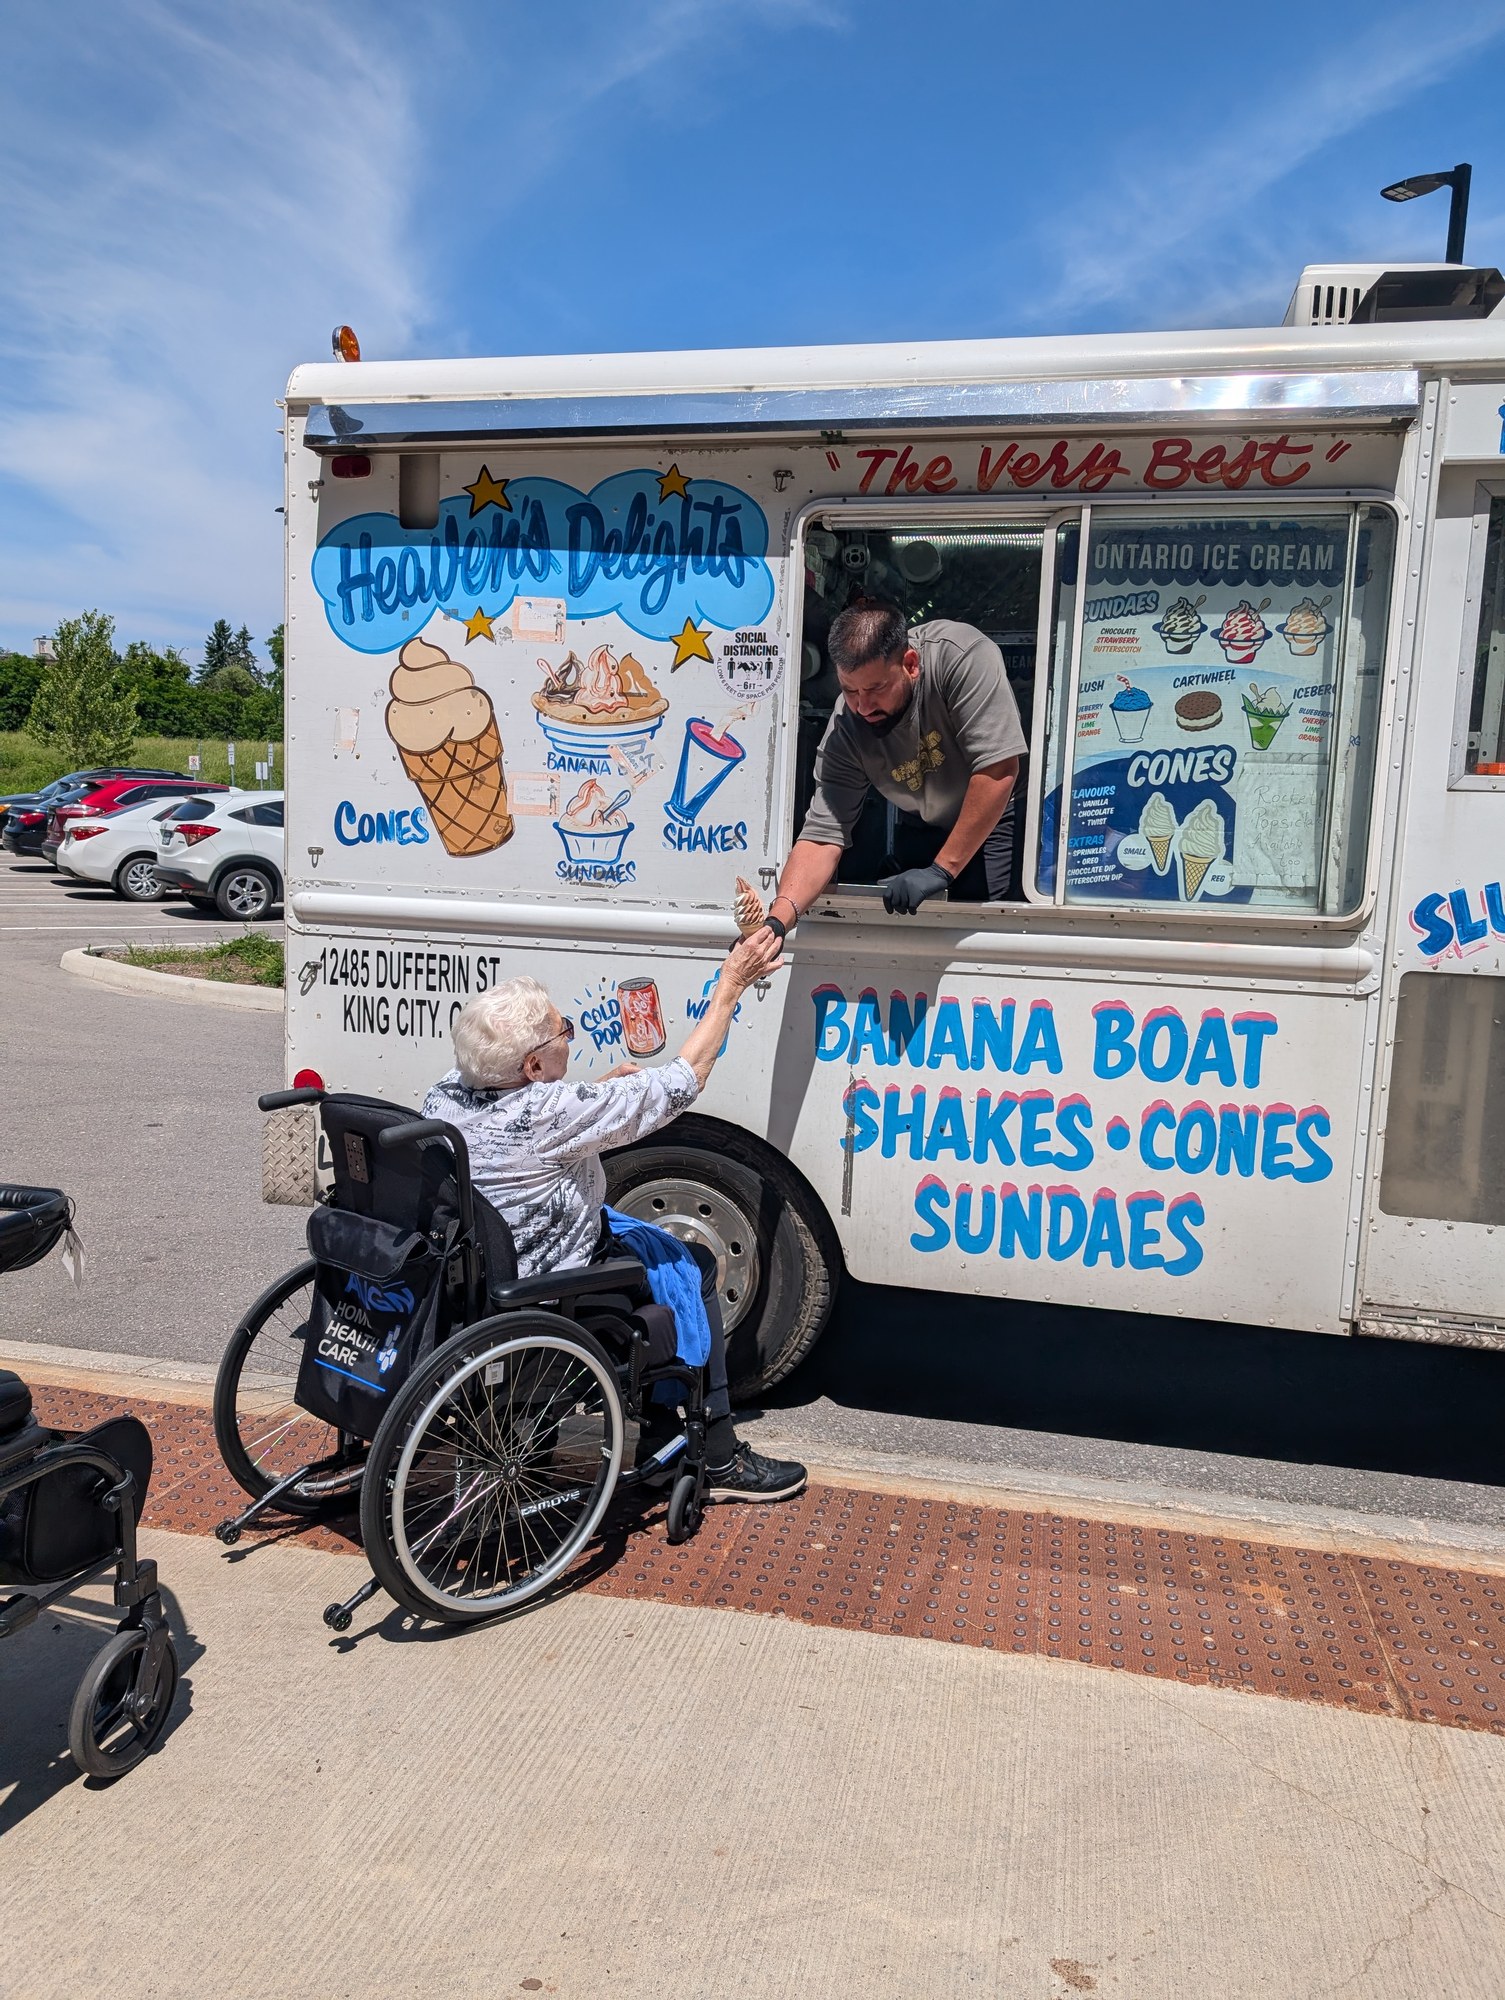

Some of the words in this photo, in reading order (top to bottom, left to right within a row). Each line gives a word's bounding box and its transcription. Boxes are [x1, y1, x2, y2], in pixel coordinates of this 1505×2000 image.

[977, 440, 1131, 491] Very
[337, 495, 562, 625] Heaven's
[566, 492, 758, 615] Delights
[1094, 544, 1194, 570] ONTARIO
[1203, 544, 1241, 570] ICE
[1250, 544, 1335, 570] CREAM
[735, 632, 767, 643] SOCIAL
[723, 645, 778, 656] DISTANCING
[1093, 645, 1141, 653] BUTTERSCOTCH
[716, 657, 725, 679] ALLOW
[723, 682, 737, 695] FEET
[746, 691, 766, 699] SPACE
[765, 681, 776, 694] PER
[774, 657, 784, 684] PERSON
[743, 682, 756, 690] 6FT
[1079, 680, 1105, 693] LUSH
[1173, 669, 1236, 688] CARTWHEEL
[1077, 728, 1102, 737] ORANGE
[1081, 721, 1096, 729] LIME
[1302, 717, 1327, 726] CHERRY
[1298, 734, 1325, 742] ORANGE
[547, 752, 611, 775] BANANA
[1127, 749, 1232, 787] CONES
[1078, 807, 1115, 817] CHOCOLATE
[1083, 799, 1108, 808] VANILLA
[1087, 818, 1107, 826] TWIST
[662, 821, 747, 854] SHAKES
[1069, 835, 1104, 847] EXTRAS
[1072, 847, 1107, 856] SPRINKLES
[1082, 857, 1099, 865] OREO
[555, 861, 636, 883] SUNDAES
[1067, 866, 1102, 876] CHOCOLATE
[320, 947, 370, 988] 12485
[376, 950, 469, 993] DUFFERIN
[476, 956, 500, 993] ST
[343, 994, 390, 1034] KING
[580, 999, 620, 1031] COLD
[590, 1020, 623, 1052] POP
[811, 983, 1063, 1075] BANANA
[1092, 999, 1278, 1088] BOAT
[840, 1079, 1094, 1171] SHAKES
[1140, 1099, 1333, 1183] CONES
[910, 1174, 1205, 1277] SUNDAES
[336, 1301, 372, 1329] HOM
[325, 1320, 380, 1353] HEALTH
[318, 1338, 359, 1367] CARE
